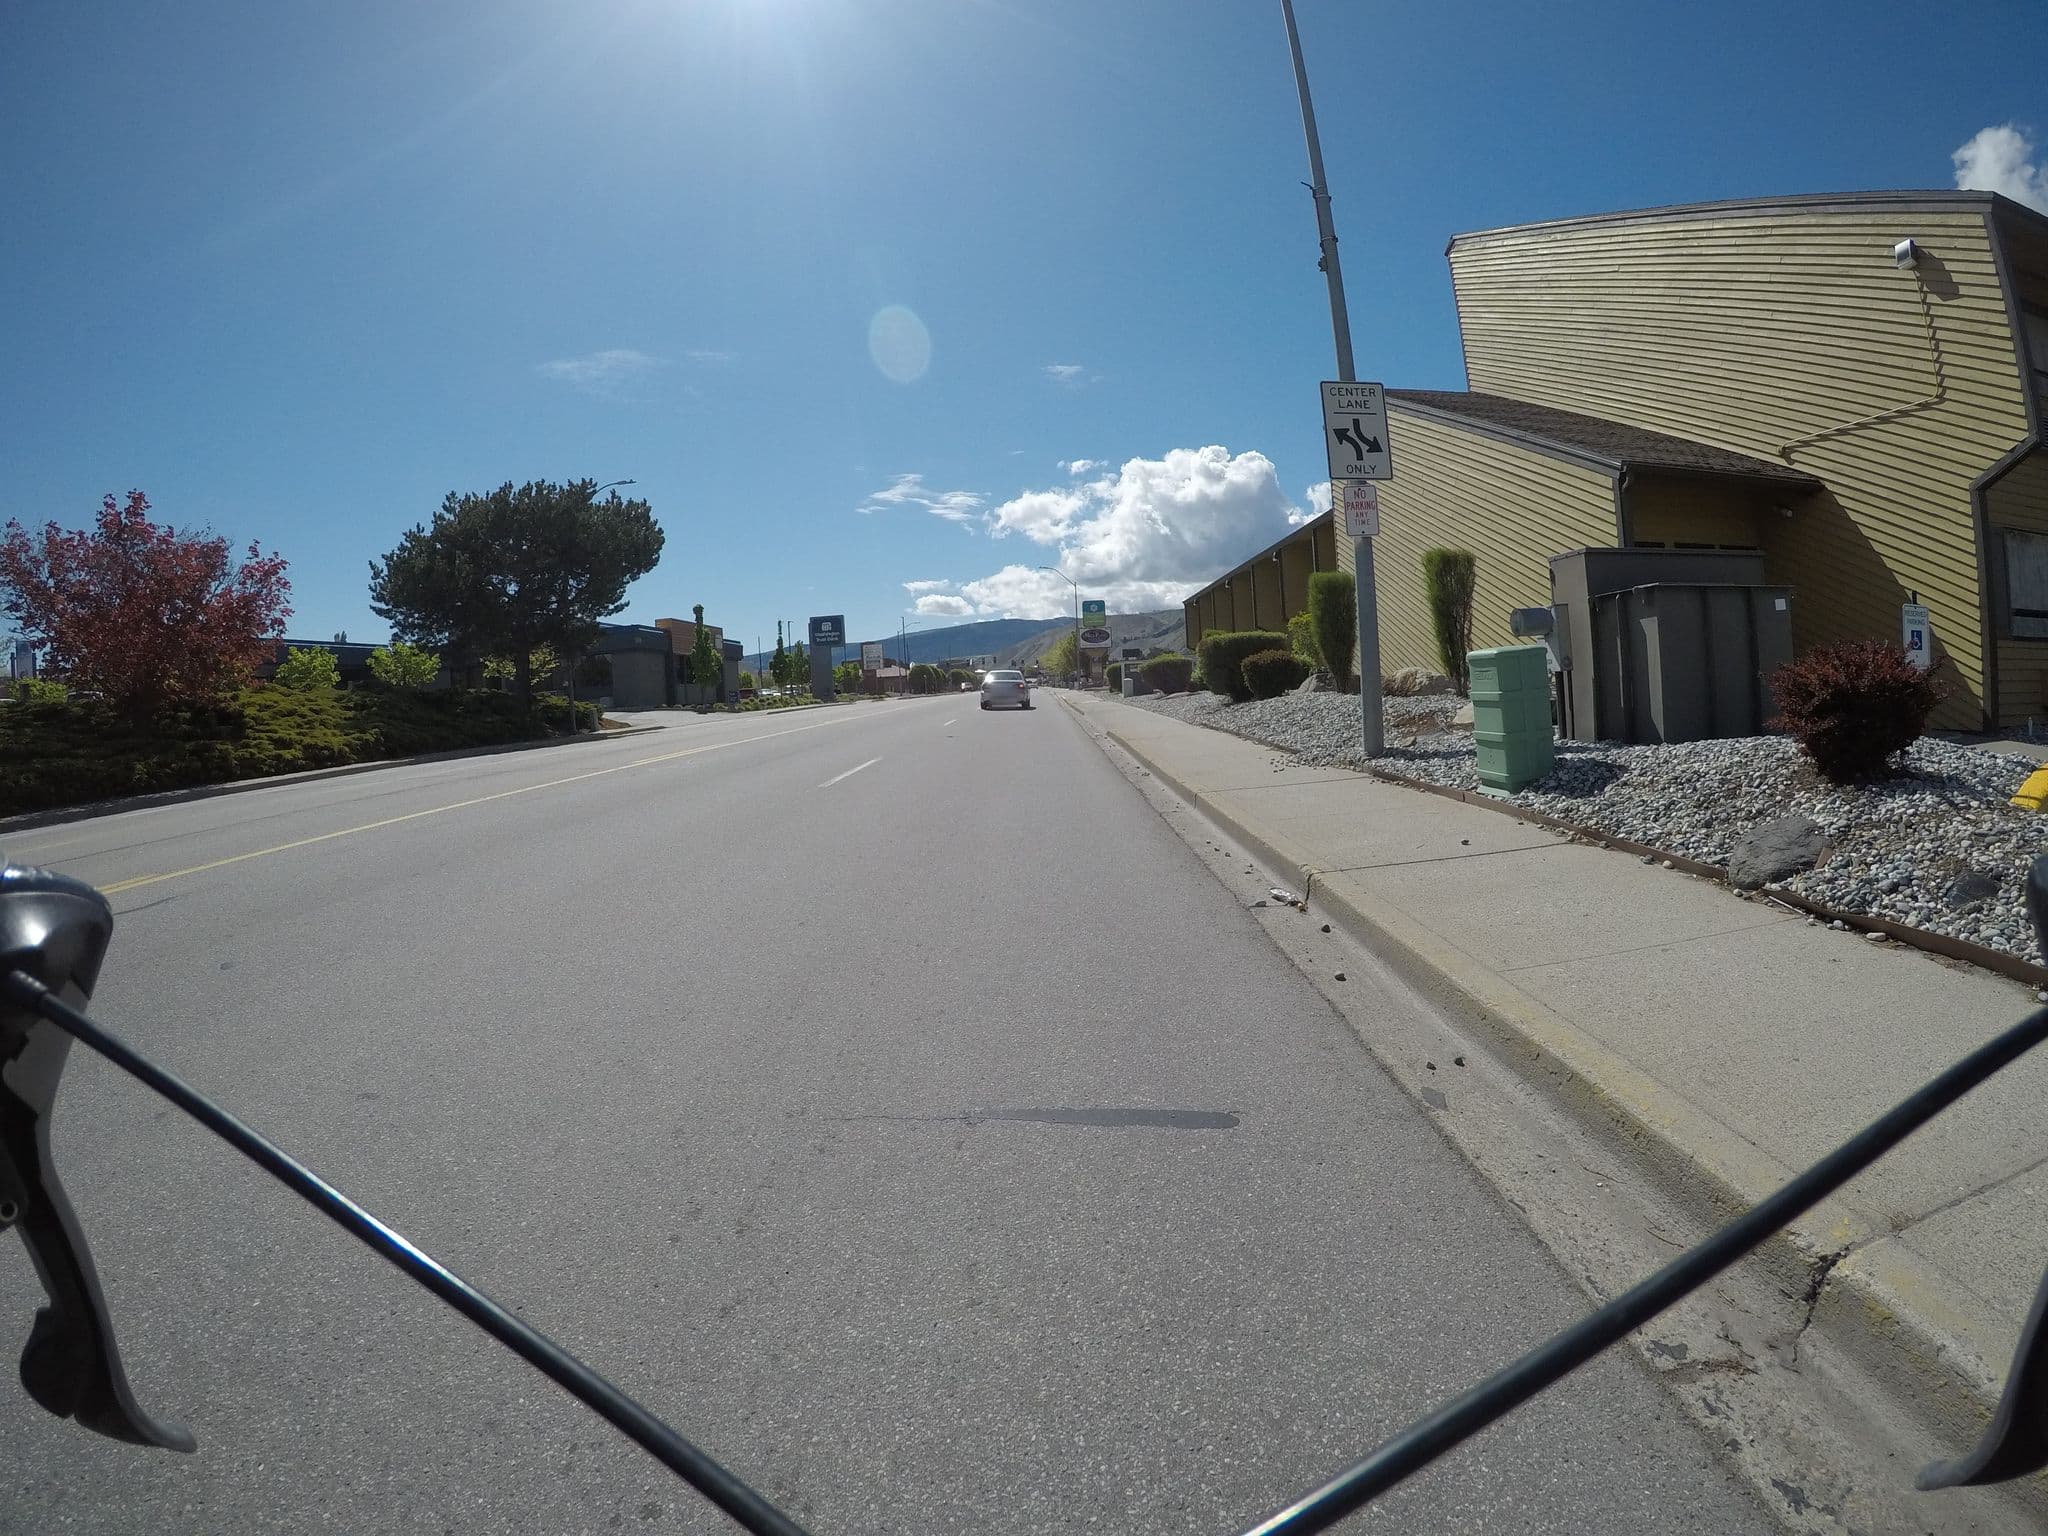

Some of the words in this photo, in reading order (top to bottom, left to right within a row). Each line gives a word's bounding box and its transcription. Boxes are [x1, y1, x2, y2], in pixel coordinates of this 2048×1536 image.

[1329, 387, 1376, 398] CENTER
[1338, 399, 1371, 410] LANE
[1346, 464, 1377, 475] ONLY
[1353, 489, 1367, 500] NO
[1346, 501, 1376, 512] PARKING
[1355, 511, 1369, 519] ANY
[1354, 518, 1371, 526] TIME
